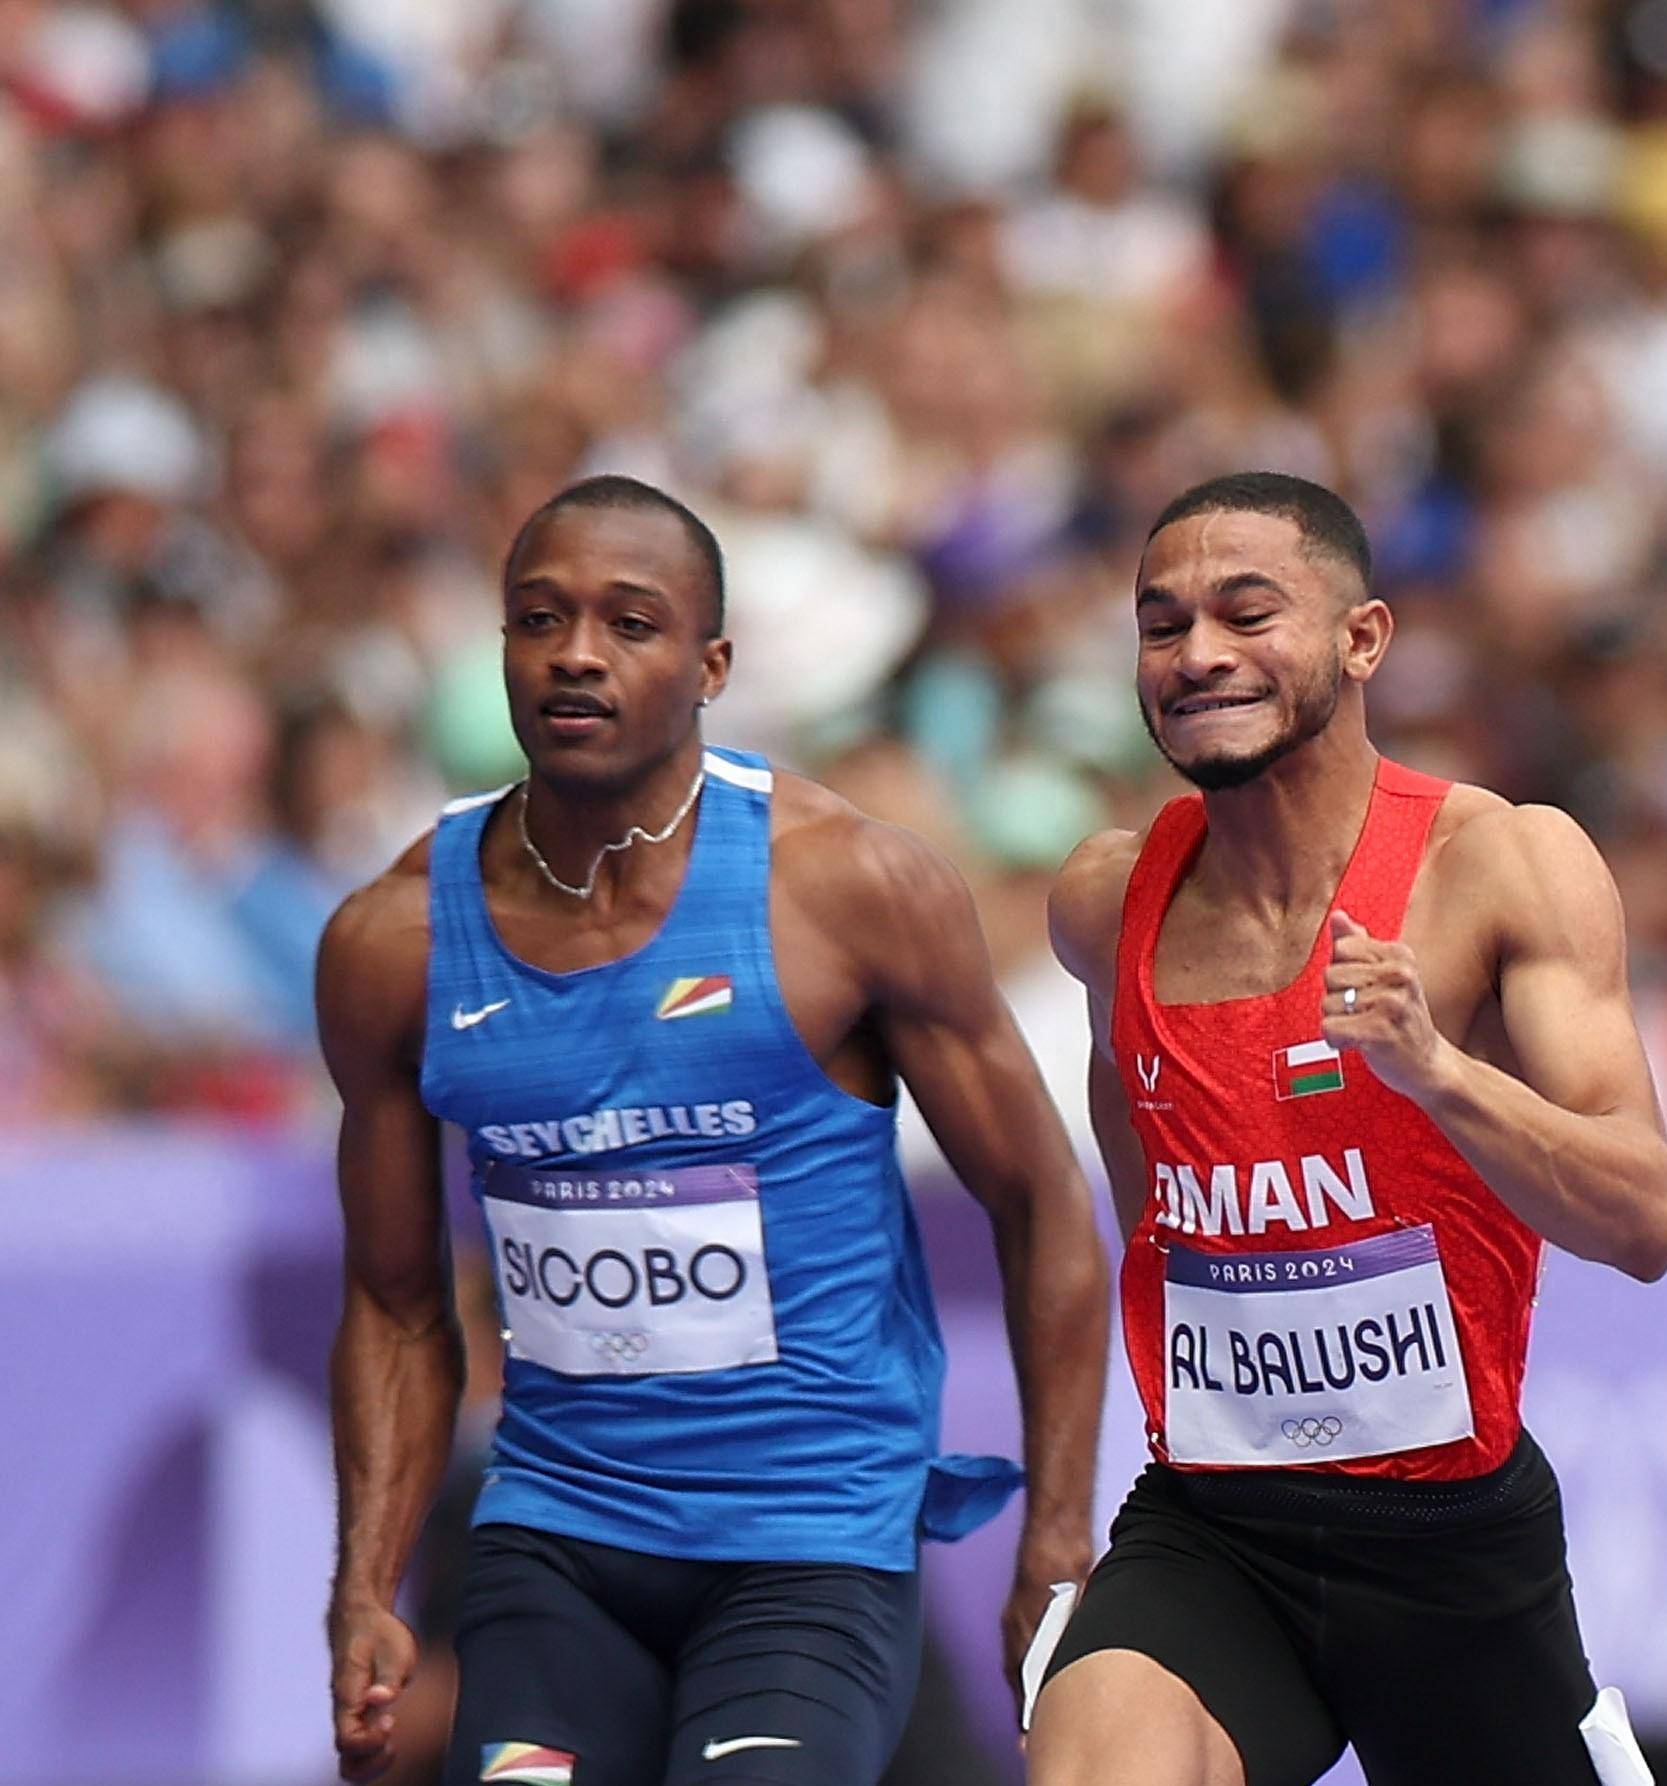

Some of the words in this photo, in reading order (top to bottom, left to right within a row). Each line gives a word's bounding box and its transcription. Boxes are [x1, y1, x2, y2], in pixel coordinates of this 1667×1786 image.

[480, 1100, 756, 1158] SEYCHELLES
[532, 1180, 601, 1200] PARIS
[606, 1180, 676, 1200] 2024
[503, 1237, 746, 1309] SICOBO
[1209, 1263, 1277, 1283] PARIS
[1285, 1256, 1354, 1281] 2024
[1171, 1323, 1224, 1391] AL
[1228, 1304, 1447, 1396] BALUSHI
